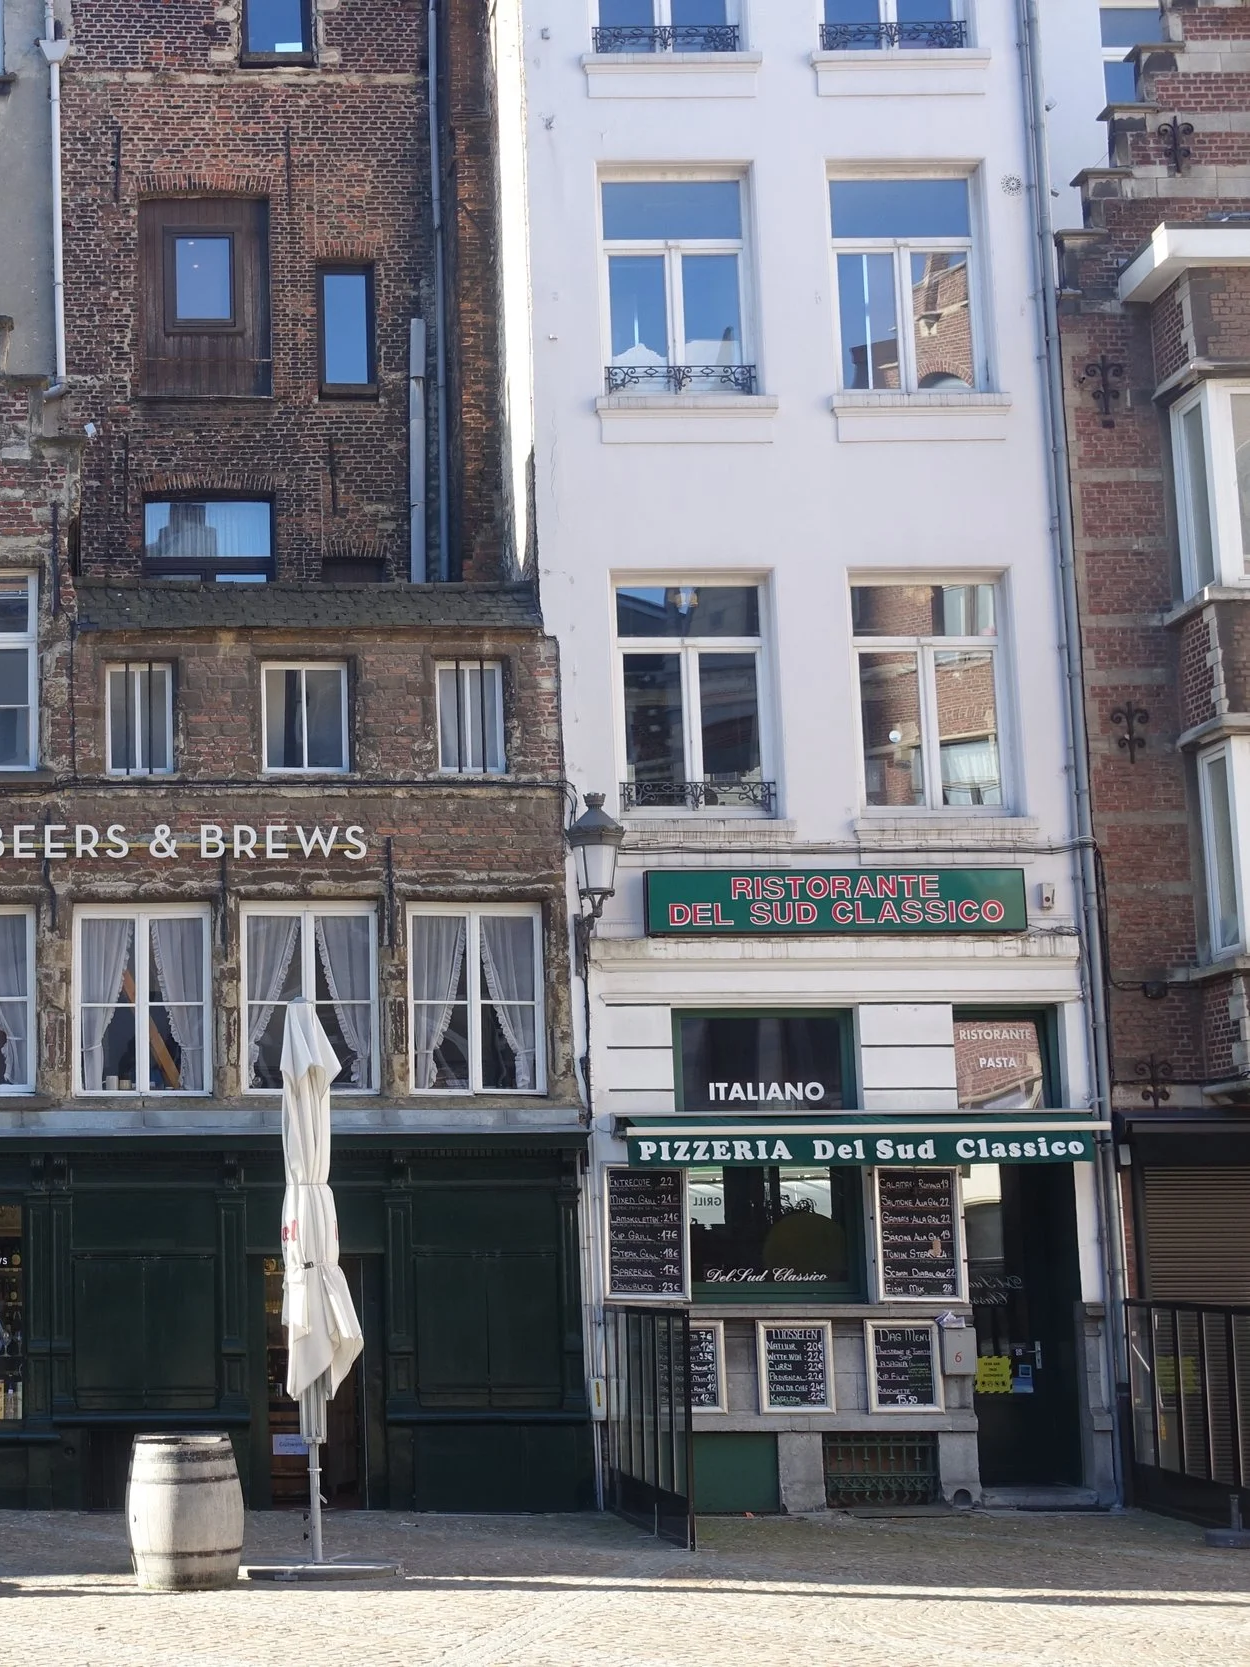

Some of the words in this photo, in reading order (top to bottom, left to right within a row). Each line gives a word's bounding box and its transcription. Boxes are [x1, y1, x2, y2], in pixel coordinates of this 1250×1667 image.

[149, 825, 177, 858] &
[200, 824, 368, 860] BREWS
[731, 874, 940, 900] RISTORANTE
[668, 903, 734, 926] DEL
[749, 901, 818, 925] SUD
[831, 899, 1005, 924] CLASSICO
[959, 1029, 1031, 1040] RISTORANTE
[979, 1057, 1017, 1068] PASTA
[708, 1082, 825, 1101] ITALIANO
[638, 1139, 793, 1162] PIZZERIA
[813, 1139, 865, 1160] Del
[875, 1138, 936, 1160] Sud
[956, 1136, 1085, 1160] Classico
[706, 1268, 734, 1283] Del
[733, 1268, 768, 1283] Sud
[772, 1267, 828, 1283] Classico
[773, 1329, 817, 1340] MOSSELEN
[954, 1351, 963, 1363] 6
